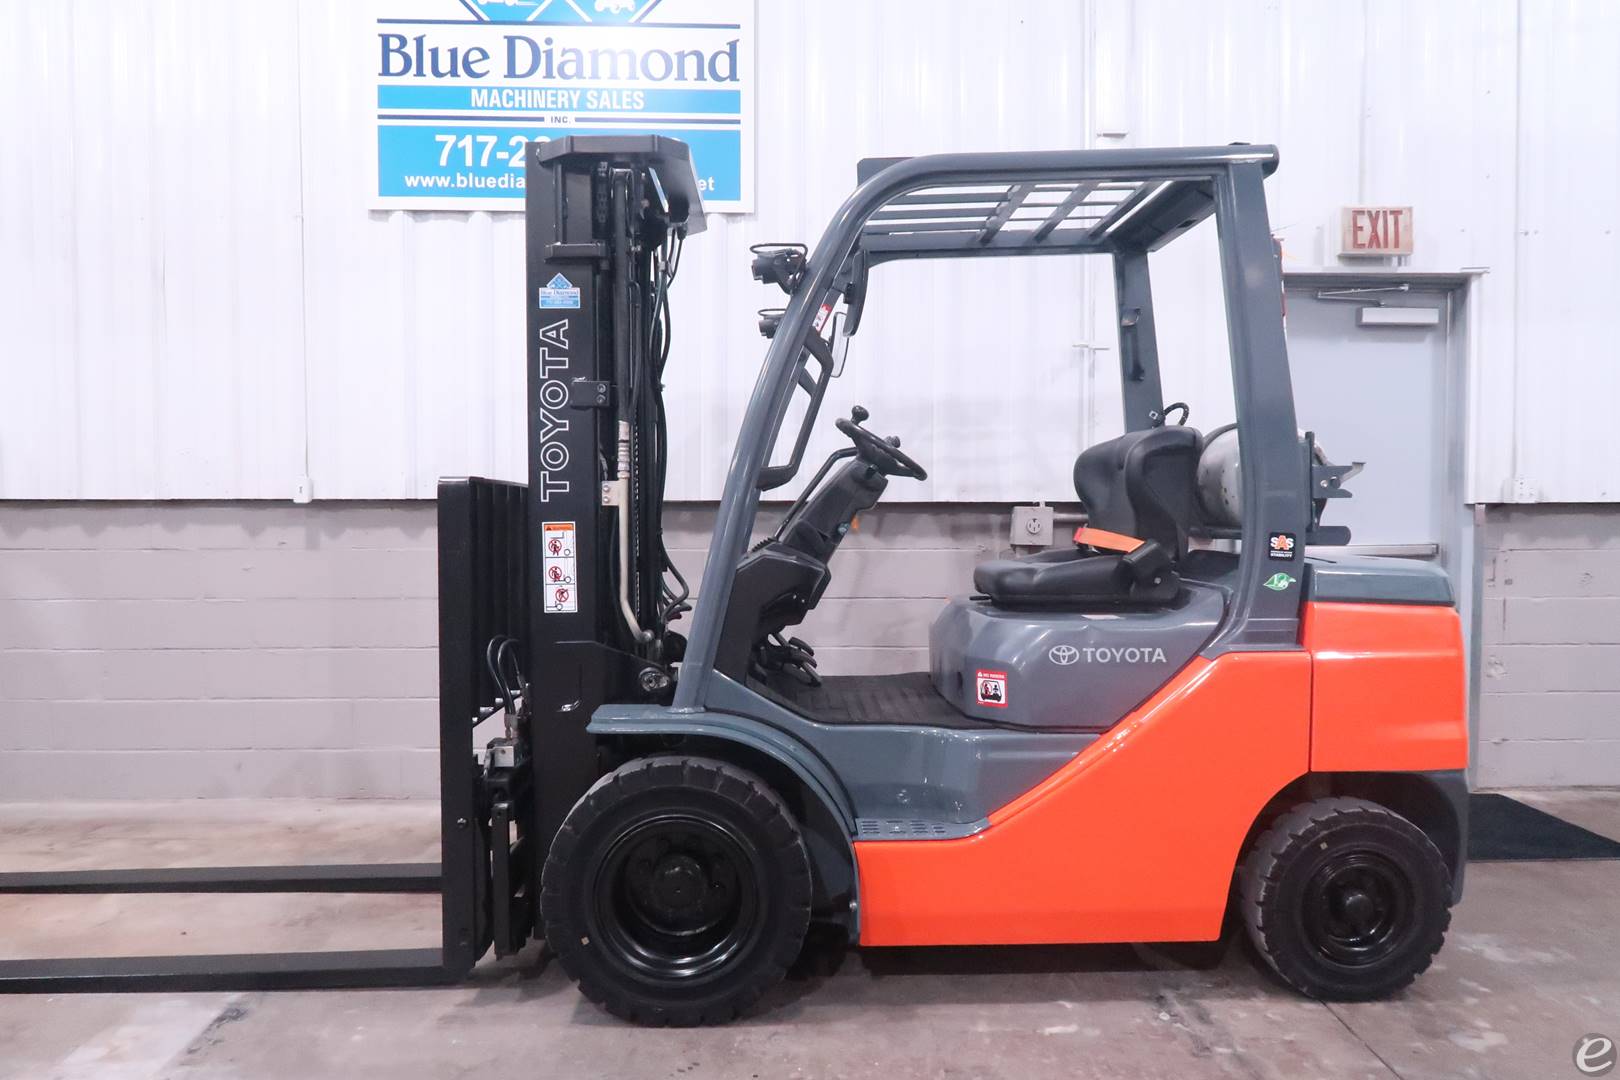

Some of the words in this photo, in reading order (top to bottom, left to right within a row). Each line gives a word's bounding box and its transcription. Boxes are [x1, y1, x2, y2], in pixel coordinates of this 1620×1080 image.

[378, 33, 491, 79] Blue
[503, 34, 740, 83] Diamond
[470, 88, 581, 110] MACHINERY
[586, 90, 645, 111] SALES
[550, 116, 571, 125] INC.
[1352, 210, 1403, 249] EXIT
[539, 319, 570, 503] TOYOTA
[1270, 535, 1294, 550] SAS
[1083, 647, 1167, 664] TOYOTA
